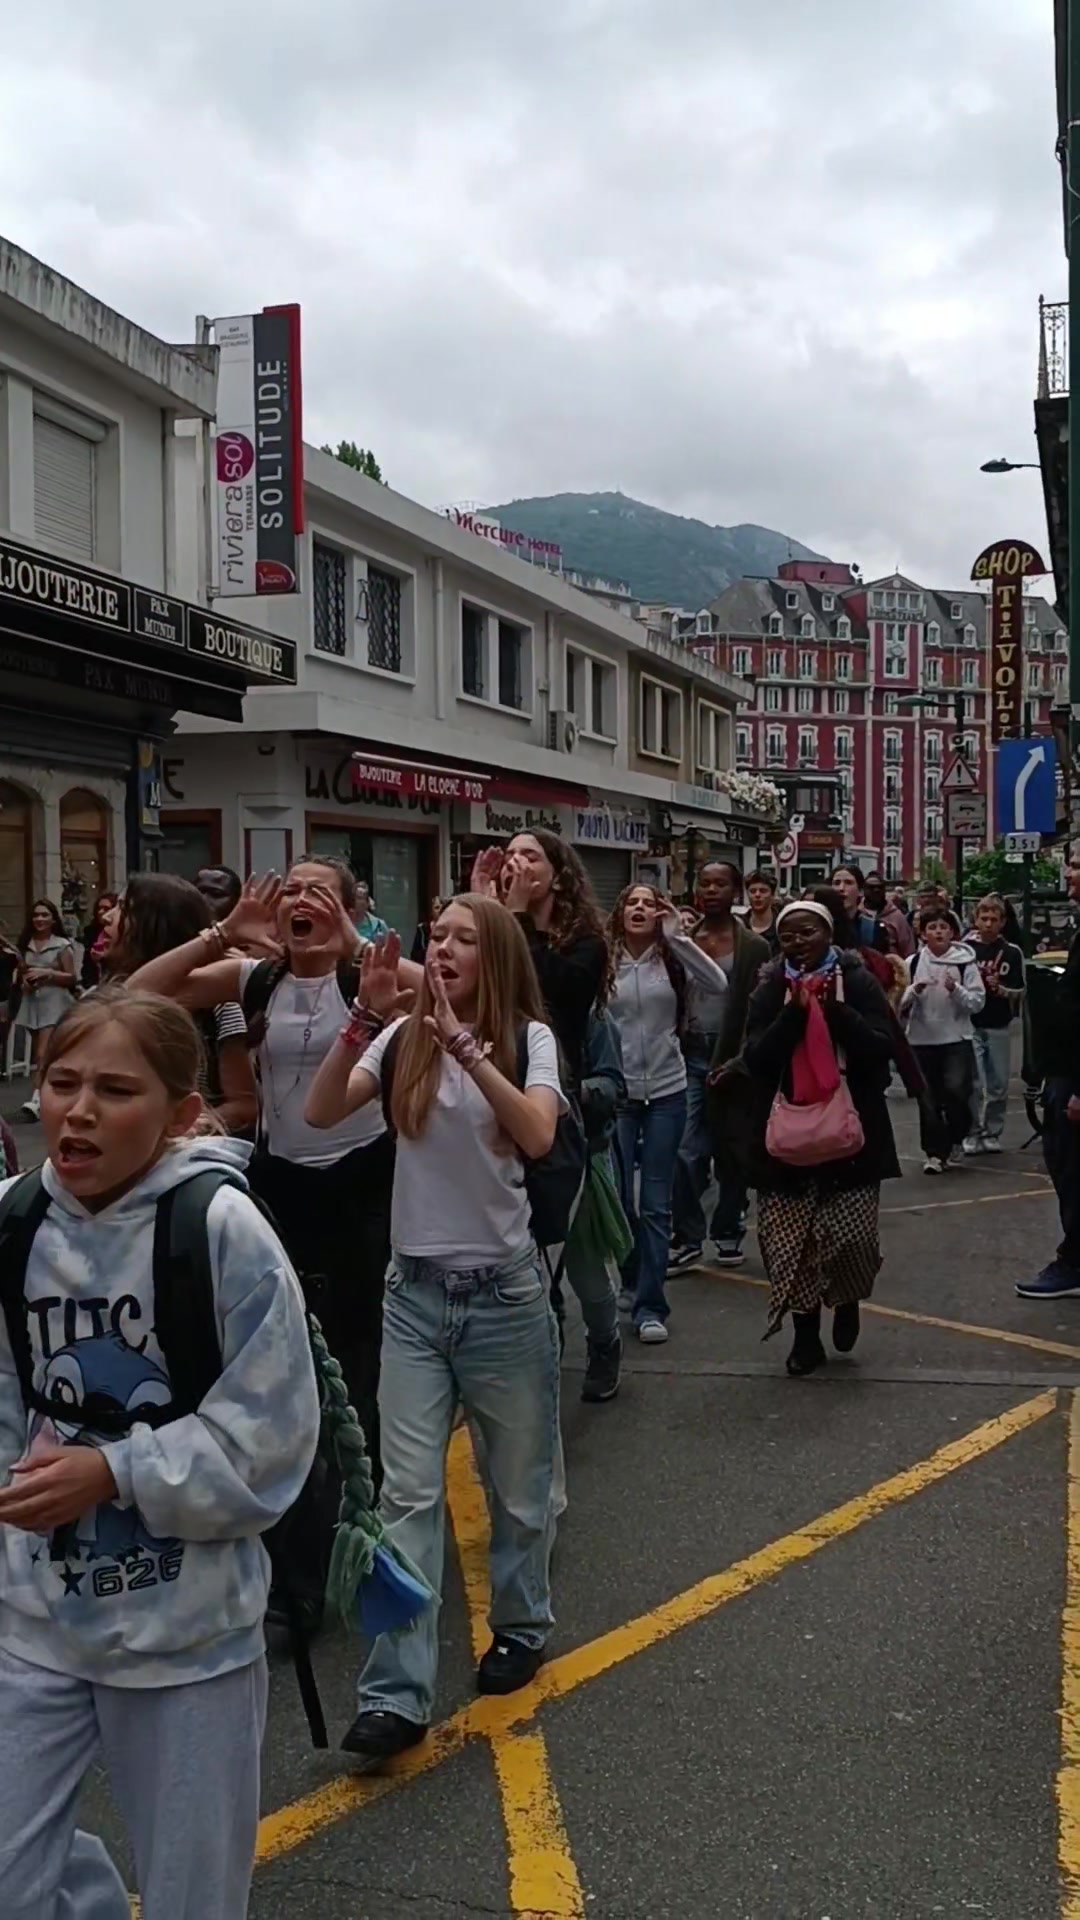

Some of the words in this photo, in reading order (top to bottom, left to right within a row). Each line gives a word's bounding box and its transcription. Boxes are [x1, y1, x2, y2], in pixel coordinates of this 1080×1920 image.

[257, 360, 283, 528] SOLITUDE
[246, 485, 254, 531] TERRASSE
[454, 507, 525, 546] Mercure
[528, 538, 563, 555] HOTEL
[975, 547, 1034, 577] SHOP
[151, 598, 169, 617] PAX
[144, 617, 176, 640] MUNDI
[204, 623, 282, 672] BOUTIQUE
[305, 766, 329, 799] LA
[359, 764, 402, 786] BIJOUTERIE
[414, 773, 426, 792] LA
[465, 781, 483, 799] D'OR
[577, 813, 610, 840] PHOTO
